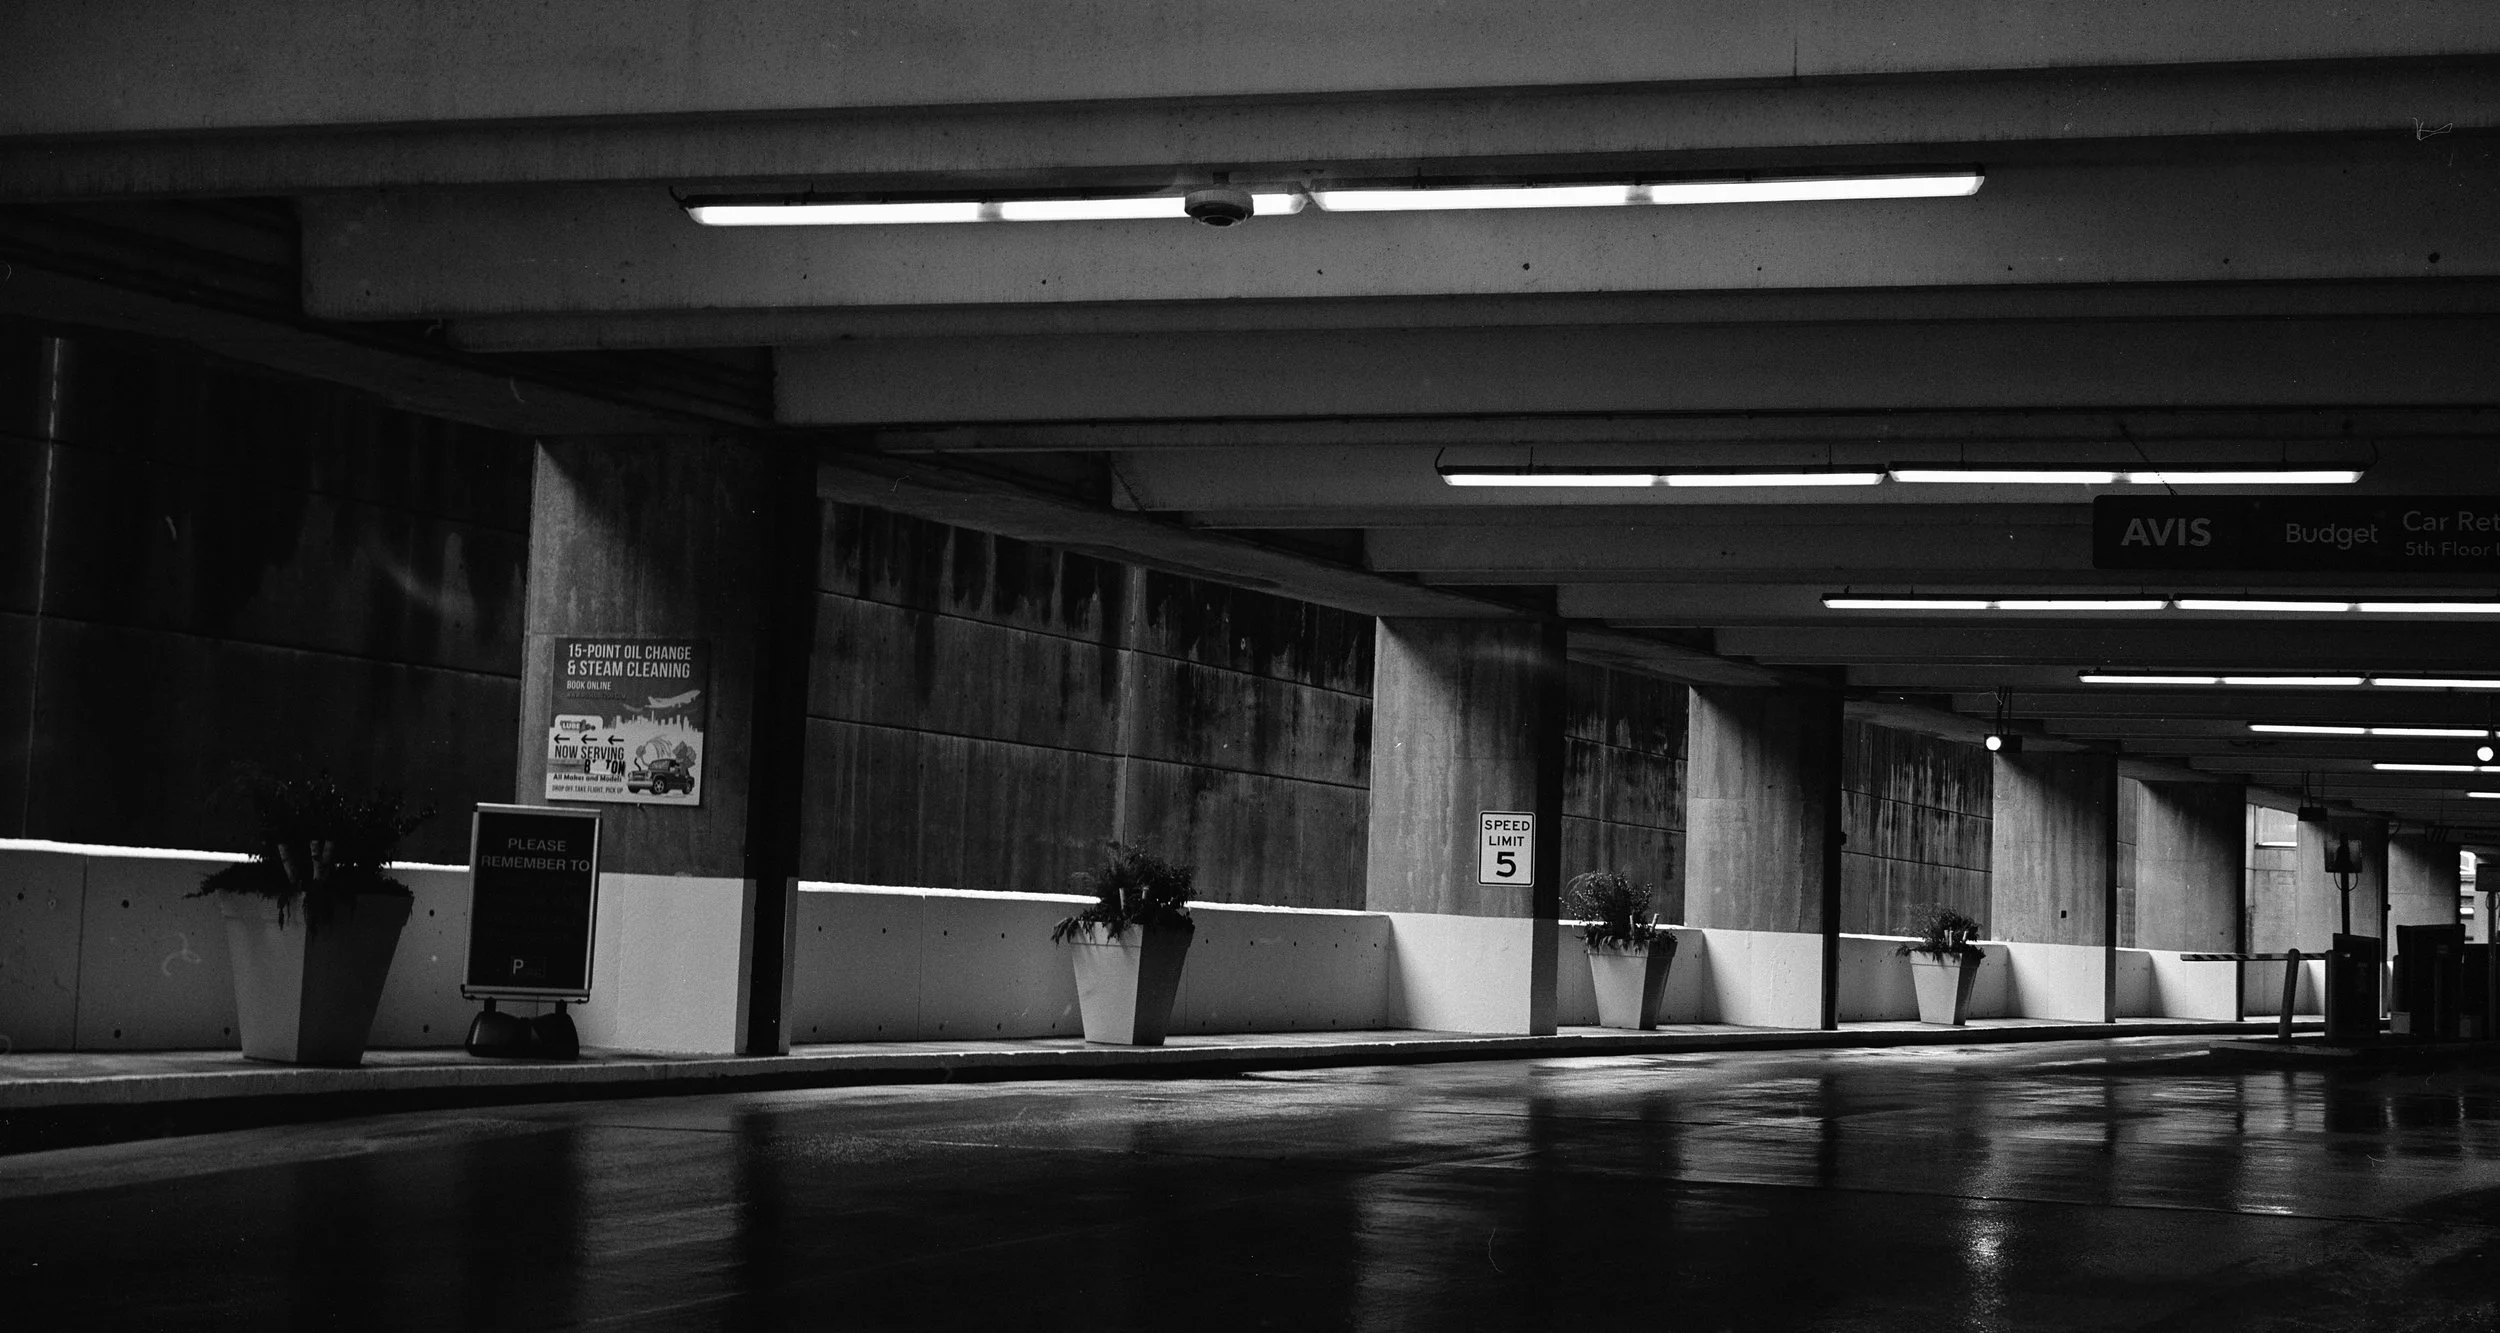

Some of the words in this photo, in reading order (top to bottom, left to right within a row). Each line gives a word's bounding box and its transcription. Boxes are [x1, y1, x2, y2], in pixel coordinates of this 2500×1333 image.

[2403, 510, 2450, 532] Car
[2458, 511, 2500, 532] Ret
[2120, 517, 2213, 547] AVIS
[2285, 523, 2379, 550] Budget
[2404, 541, 2435, 557] 5th
[2441, 541, 2491, 557] Floor
[568, 644, 621, 659] 15-POINT
[624, 645, 642, 660] OIL
[645, 646, 692, 661] CHANGE
[567, 660, 576, 676] &
[579, 660, 623, 677] STEAM
[627, 661, 691, 678] CLEANING
[567, 680, 585, 690] BOOK
[587, 681, 612, 690] ONLINE
[555, 745, 578, 759] NOW
[581, 746, 625, 761] SERVING
[1484, 820, 1530, 831] SPEED
[508, 837, 567, 853] PLEASE
[1489, 836, 1524, 847] LIMIT
[481, 855, 566, 871] REMEMBER
[570, 859, 590, 872] TO
[1496, 851, 1516, 877] 5
[512, 958, 524, 976] P
